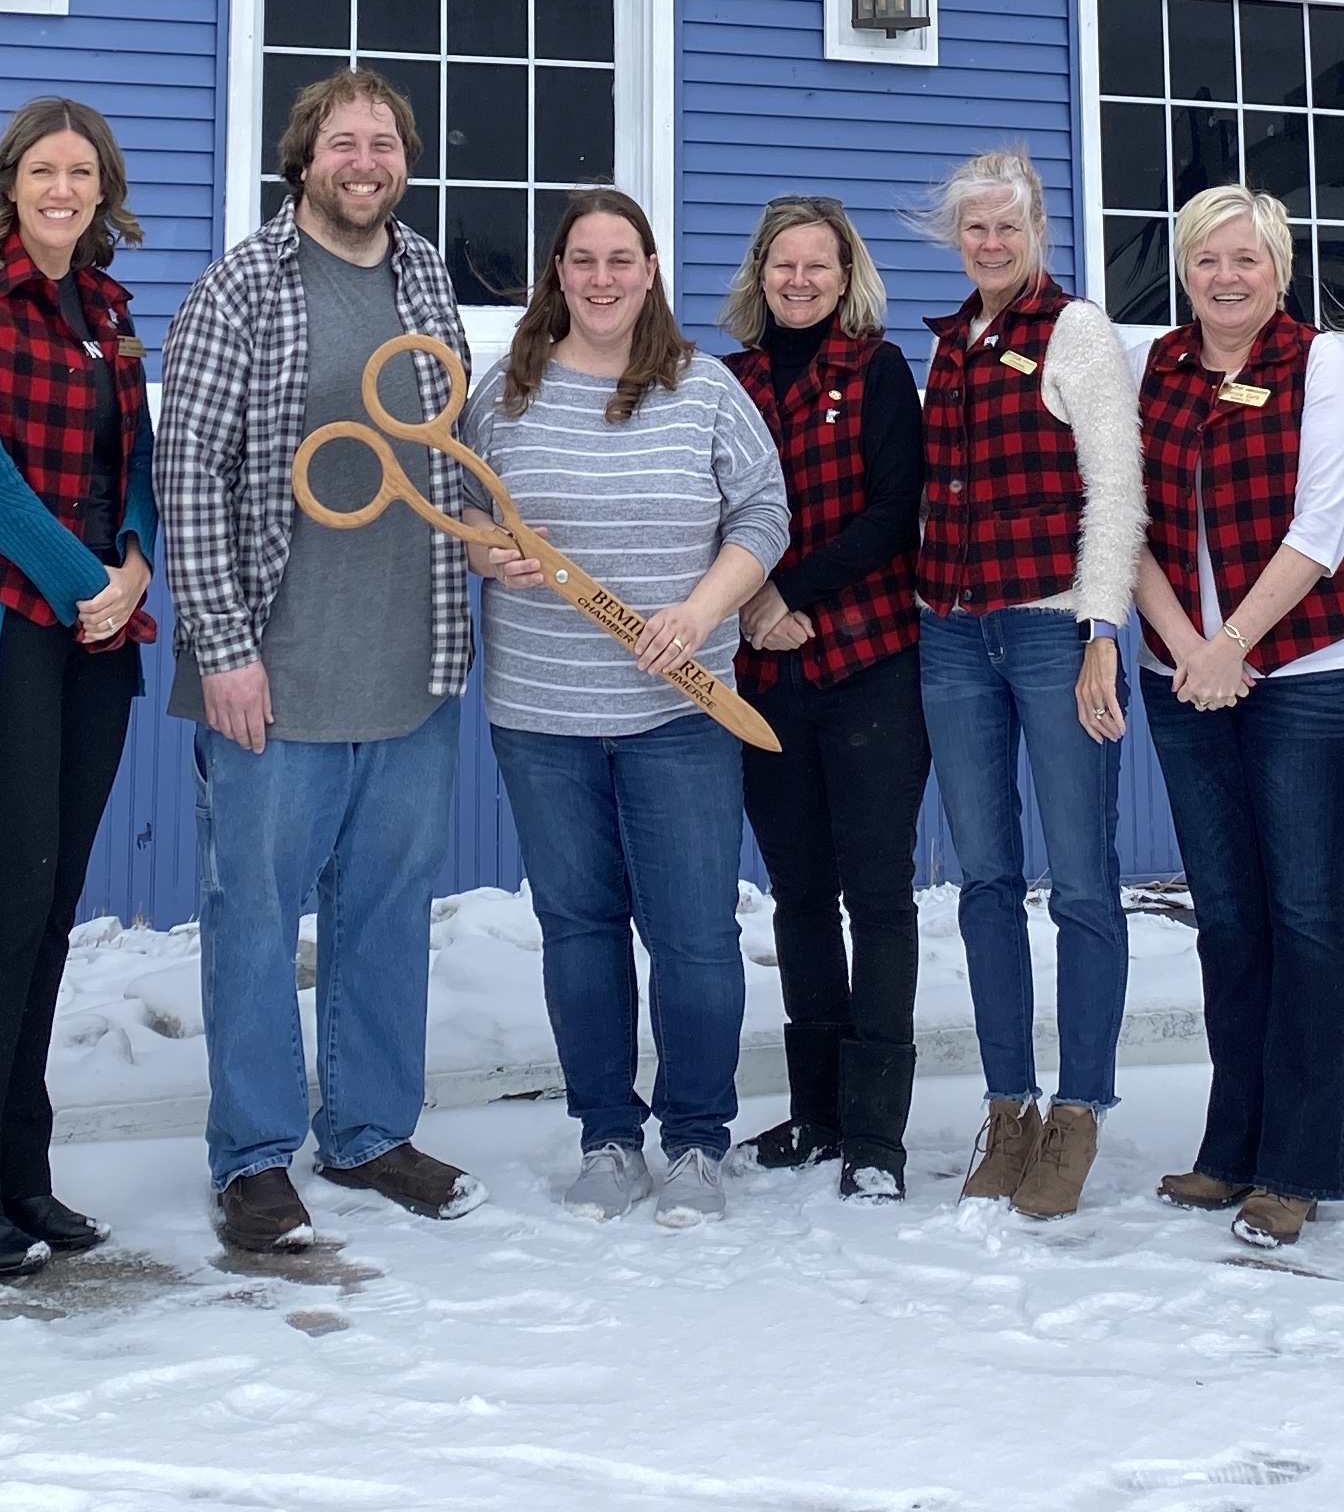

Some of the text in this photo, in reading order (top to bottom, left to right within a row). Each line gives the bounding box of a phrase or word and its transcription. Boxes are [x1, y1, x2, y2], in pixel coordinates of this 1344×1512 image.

[577, 597, 717, 710] CHAMBER MMERCE
[591, 590, 716, 696] BEMI REA
